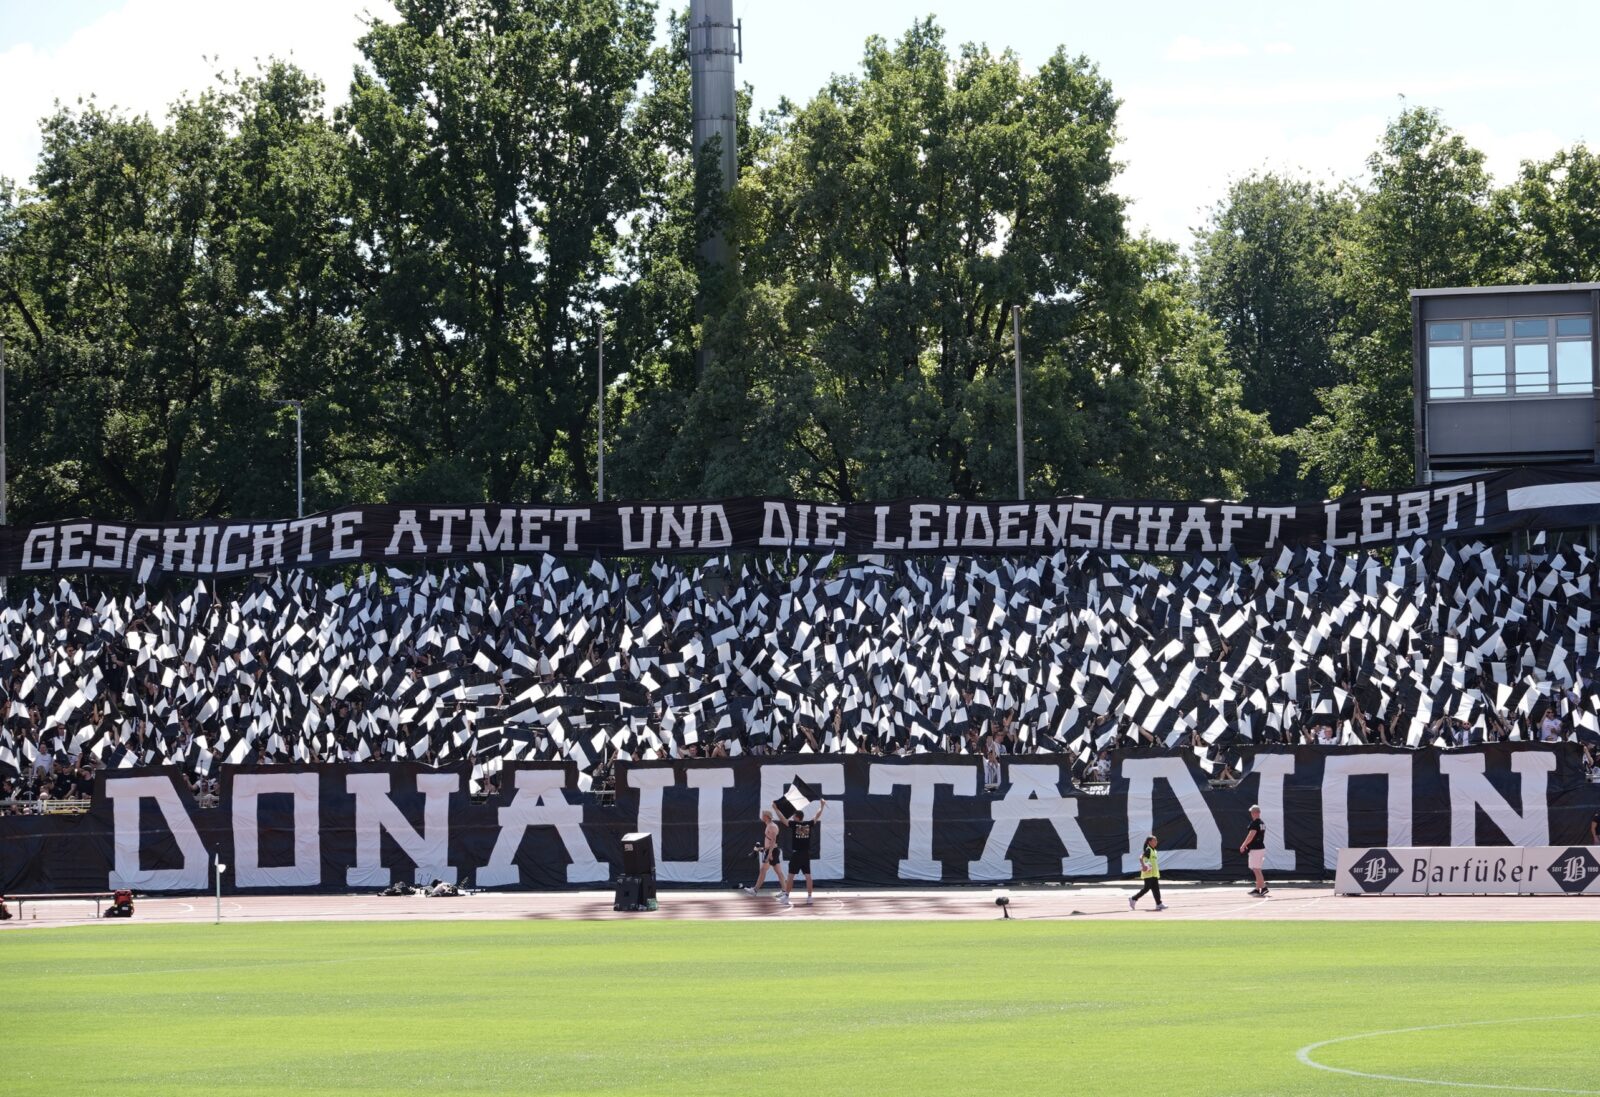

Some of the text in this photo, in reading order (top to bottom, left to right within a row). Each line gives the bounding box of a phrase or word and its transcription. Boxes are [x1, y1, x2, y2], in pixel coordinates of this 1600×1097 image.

[21, 481, 1486, 573] GESCHICHTE ATMET UND DIE LEIDENSCHAFT LEBT!
[105, 751, 1557, 891] DONAUSTADION
[1363, 857, 1387, 883] B
[1411, 858, 1539, 882] Barfüßer
[1562, 856, 1586, 882] B
